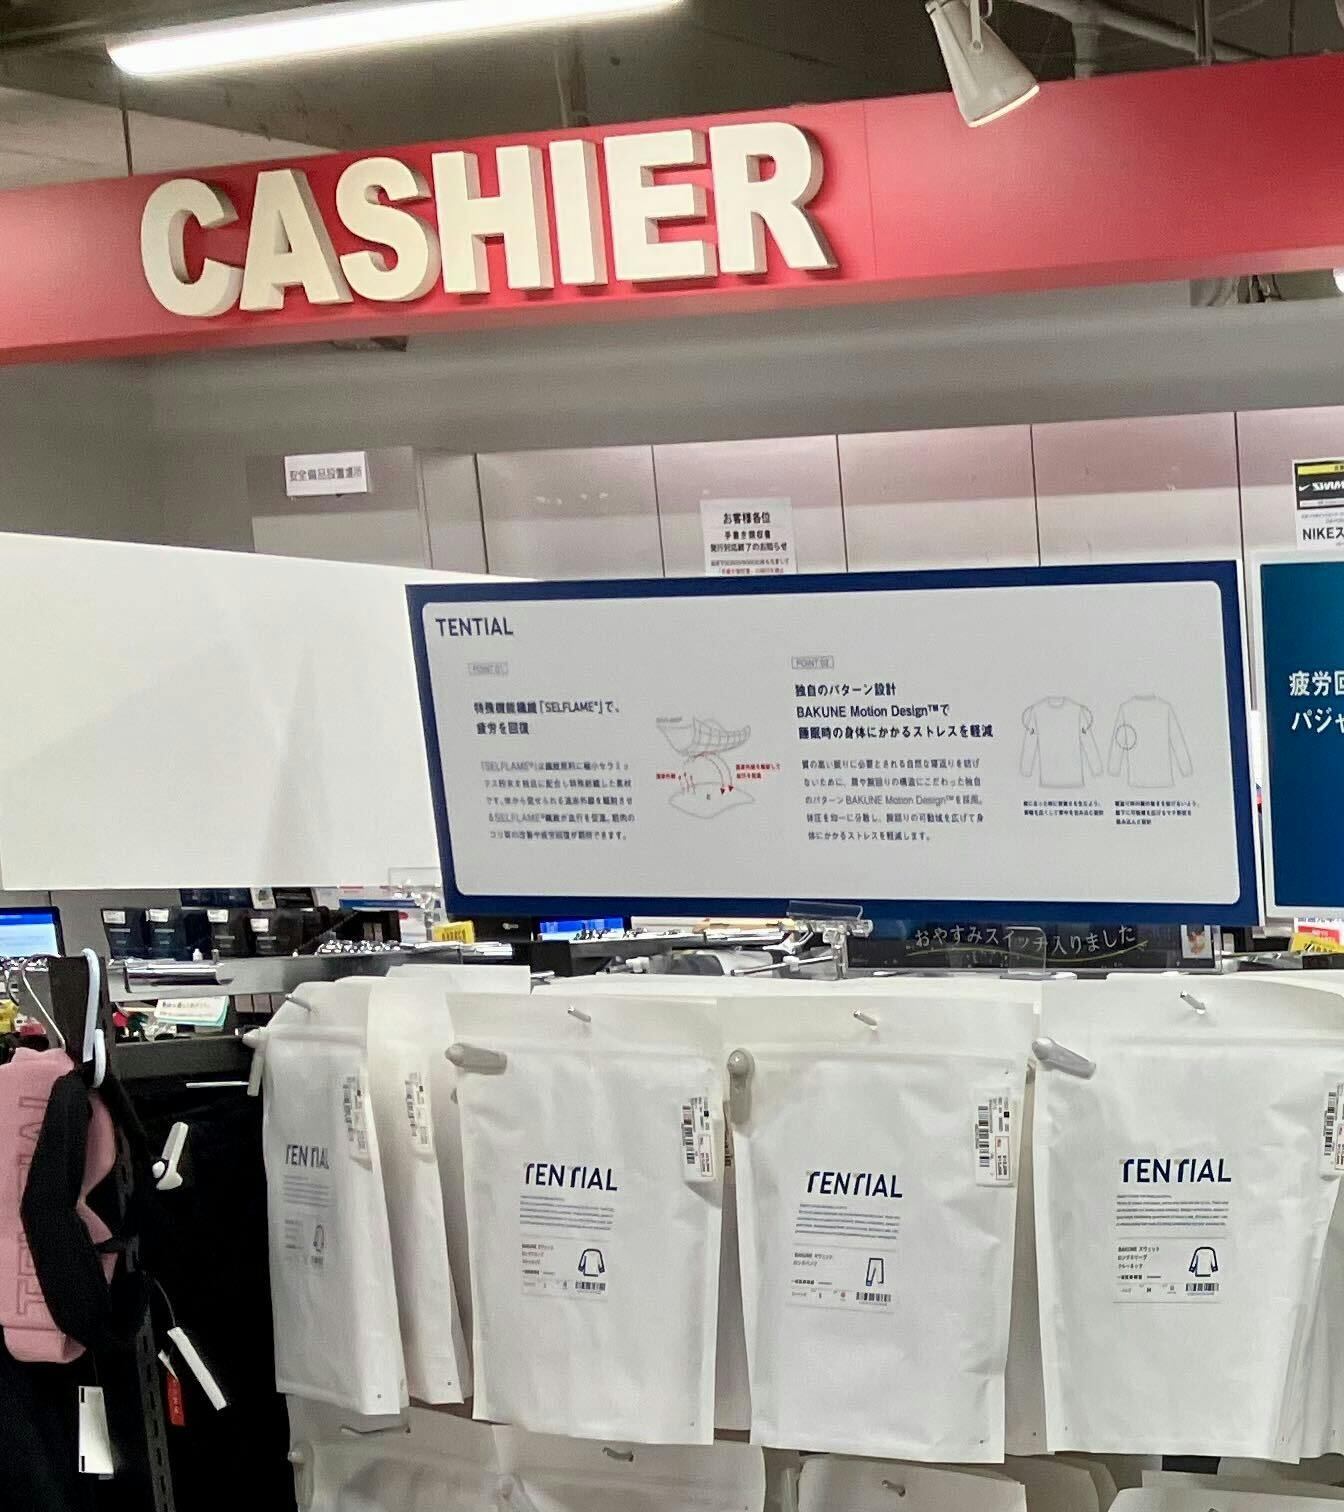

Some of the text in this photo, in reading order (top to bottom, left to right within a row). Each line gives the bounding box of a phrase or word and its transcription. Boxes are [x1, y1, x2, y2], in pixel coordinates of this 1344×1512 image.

[141, 121, 838, 317] CASHIER
[435, 616, 514, 638] TENTIAL
[795, 682, 897, 698] 独自のパターン設計
[796, 706, 847, 718] BAKUNE
[849, 705, 888, 718] Motion
[798, 724, 994, 740] 睡眠時の身体にかかるストレスを軽減
[914, 924, 1137, 956] おやすみスイッチ入りました
[524, 1162, 619, 1192] TENTIAL
[806, 1170, 903, 1199] TENTIAL
[1120, 1158, 1232, 1185] TENTIAL
